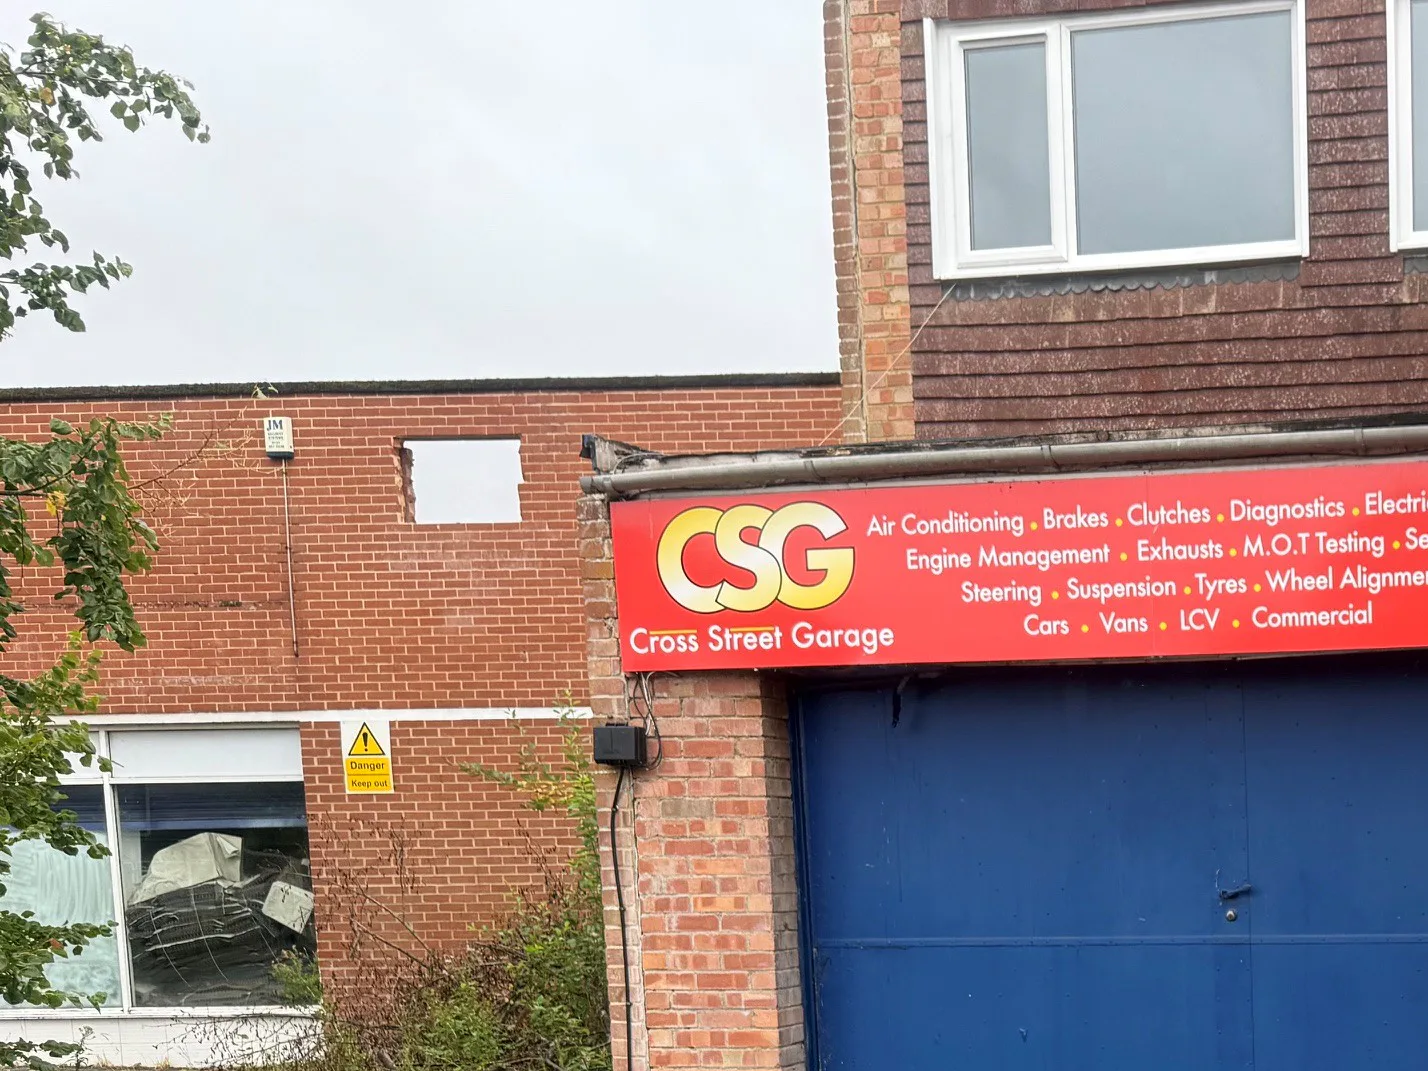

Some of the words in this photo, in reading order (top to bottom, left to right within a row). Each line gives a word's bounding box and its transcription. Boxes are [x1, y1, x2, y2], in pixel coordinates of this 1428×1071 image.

[266, 419, 284, 432] JM
[867, 516, 896, 536] Air
[902, 511, 1023, 537] Conditioning
[1044, 505, 1108, 529] Brakes
[1128, 502, 1210, 526] Clutches
[1231, 496, 1345, 526] Diagnostics
[658, 502, 853, 612] CSG
[907, 548, 971, 575] Engine
[979, 544, 1110, 571] Management
[1138, 539, 1223, 561] Exhausts
[1244, 533, 1310, 557] M.O.T
[1315, 531, 1384, 558] Testing
[962, 581, 1041, 606] Steering
[1067, 576, 1176, 604] Suspension
[1195, 573, 1247, 600] Tyres
[1265, 567, 1333, 592] Wheel
[1024, 614, 1069, 635] Cars
[1099, 612, 1148, 633] Vans
[1181, 608, 1219, 630] LCV
[1252, 601, 1372, 628] Commercial
[630, 628, 699, 654] Cross
[709, 625, 782, 651] Street
[792, 622, 894, 654] Garage
[350, 760, 385, 772] Danger
[351, 779, 372, 789] Keep
[373, 779, 388, 788] out
